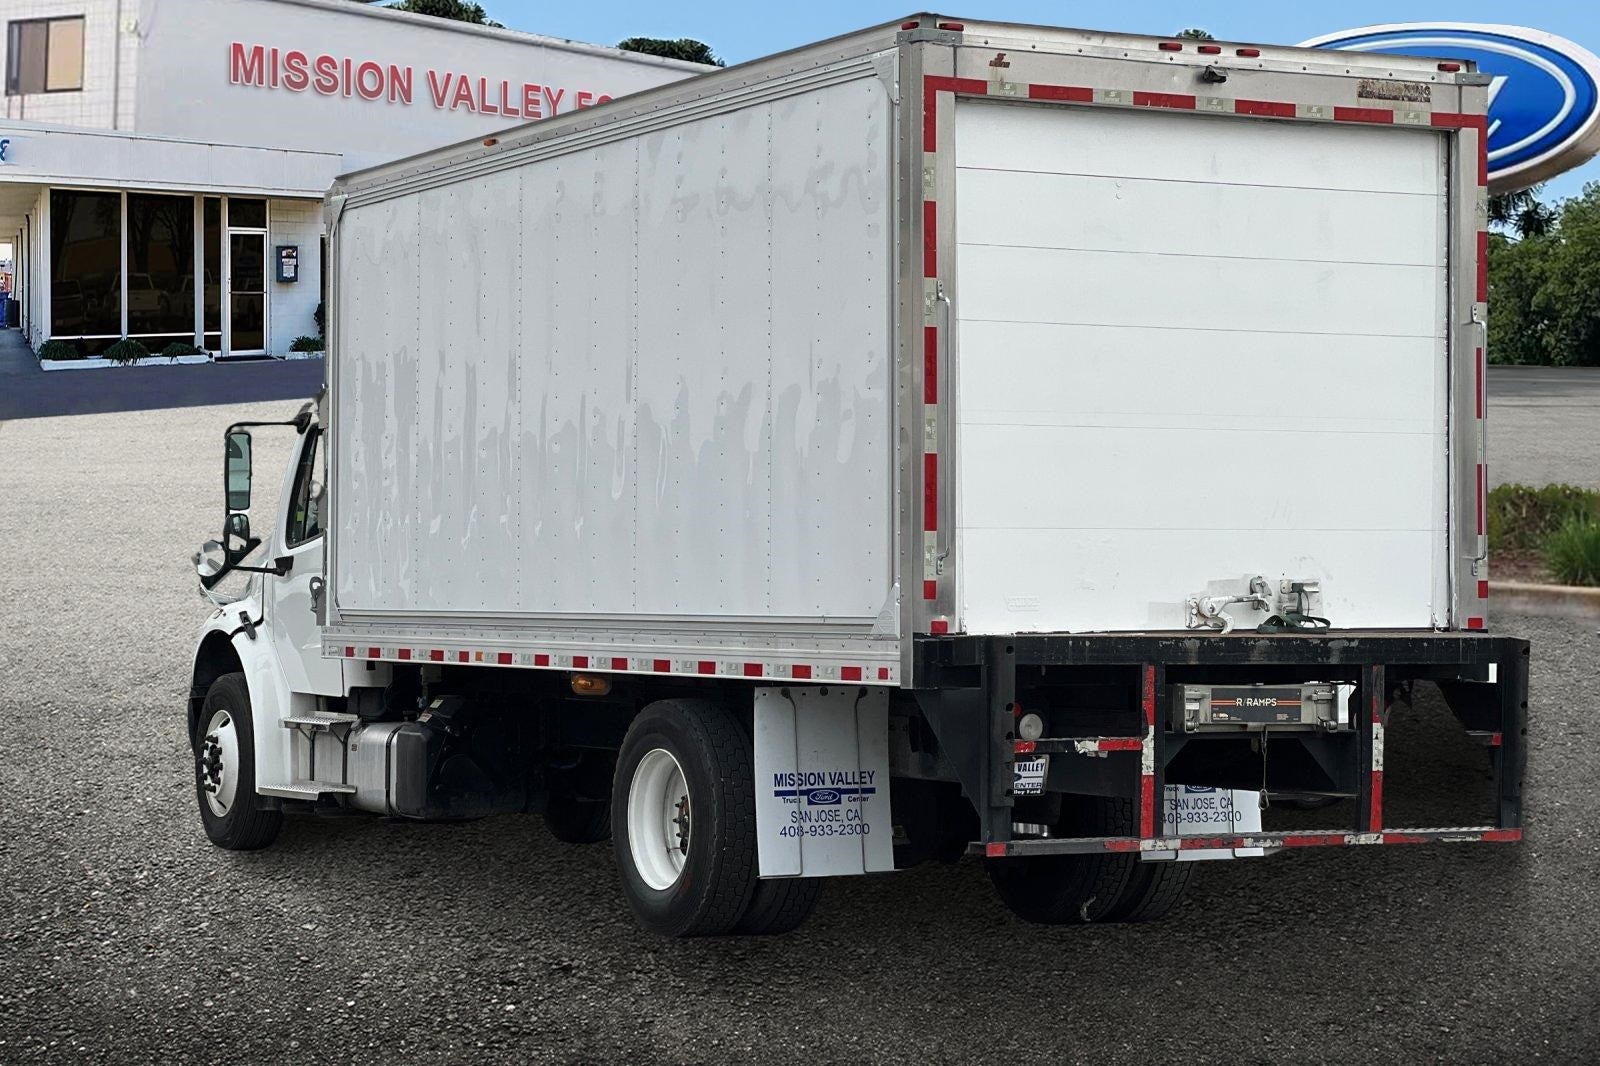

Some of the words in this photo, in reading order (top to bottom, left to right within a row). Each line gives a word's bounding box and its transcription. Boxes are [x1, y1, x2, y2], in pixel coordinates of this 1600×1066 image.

[229, 41, 414, 105] MISSION
[426, 69, 566, 120] VALLEY
[1017, 762, 1045, 772] VALLEY
[774, 772, 826, 788] MISSION
[829, 770, 876, 786] VALLEY
[814, 792, 833, 801] Ford
[1170, 799, 1189, 811] SAN
[1191, 798, 1218, 811] JOSE,
[790, 810, 812, 823] SAN
[814, 809, 844, 823] JOSE,
[846, 808, 861, 821] CA
[779, 823, 871, 838] 408-933-2300
